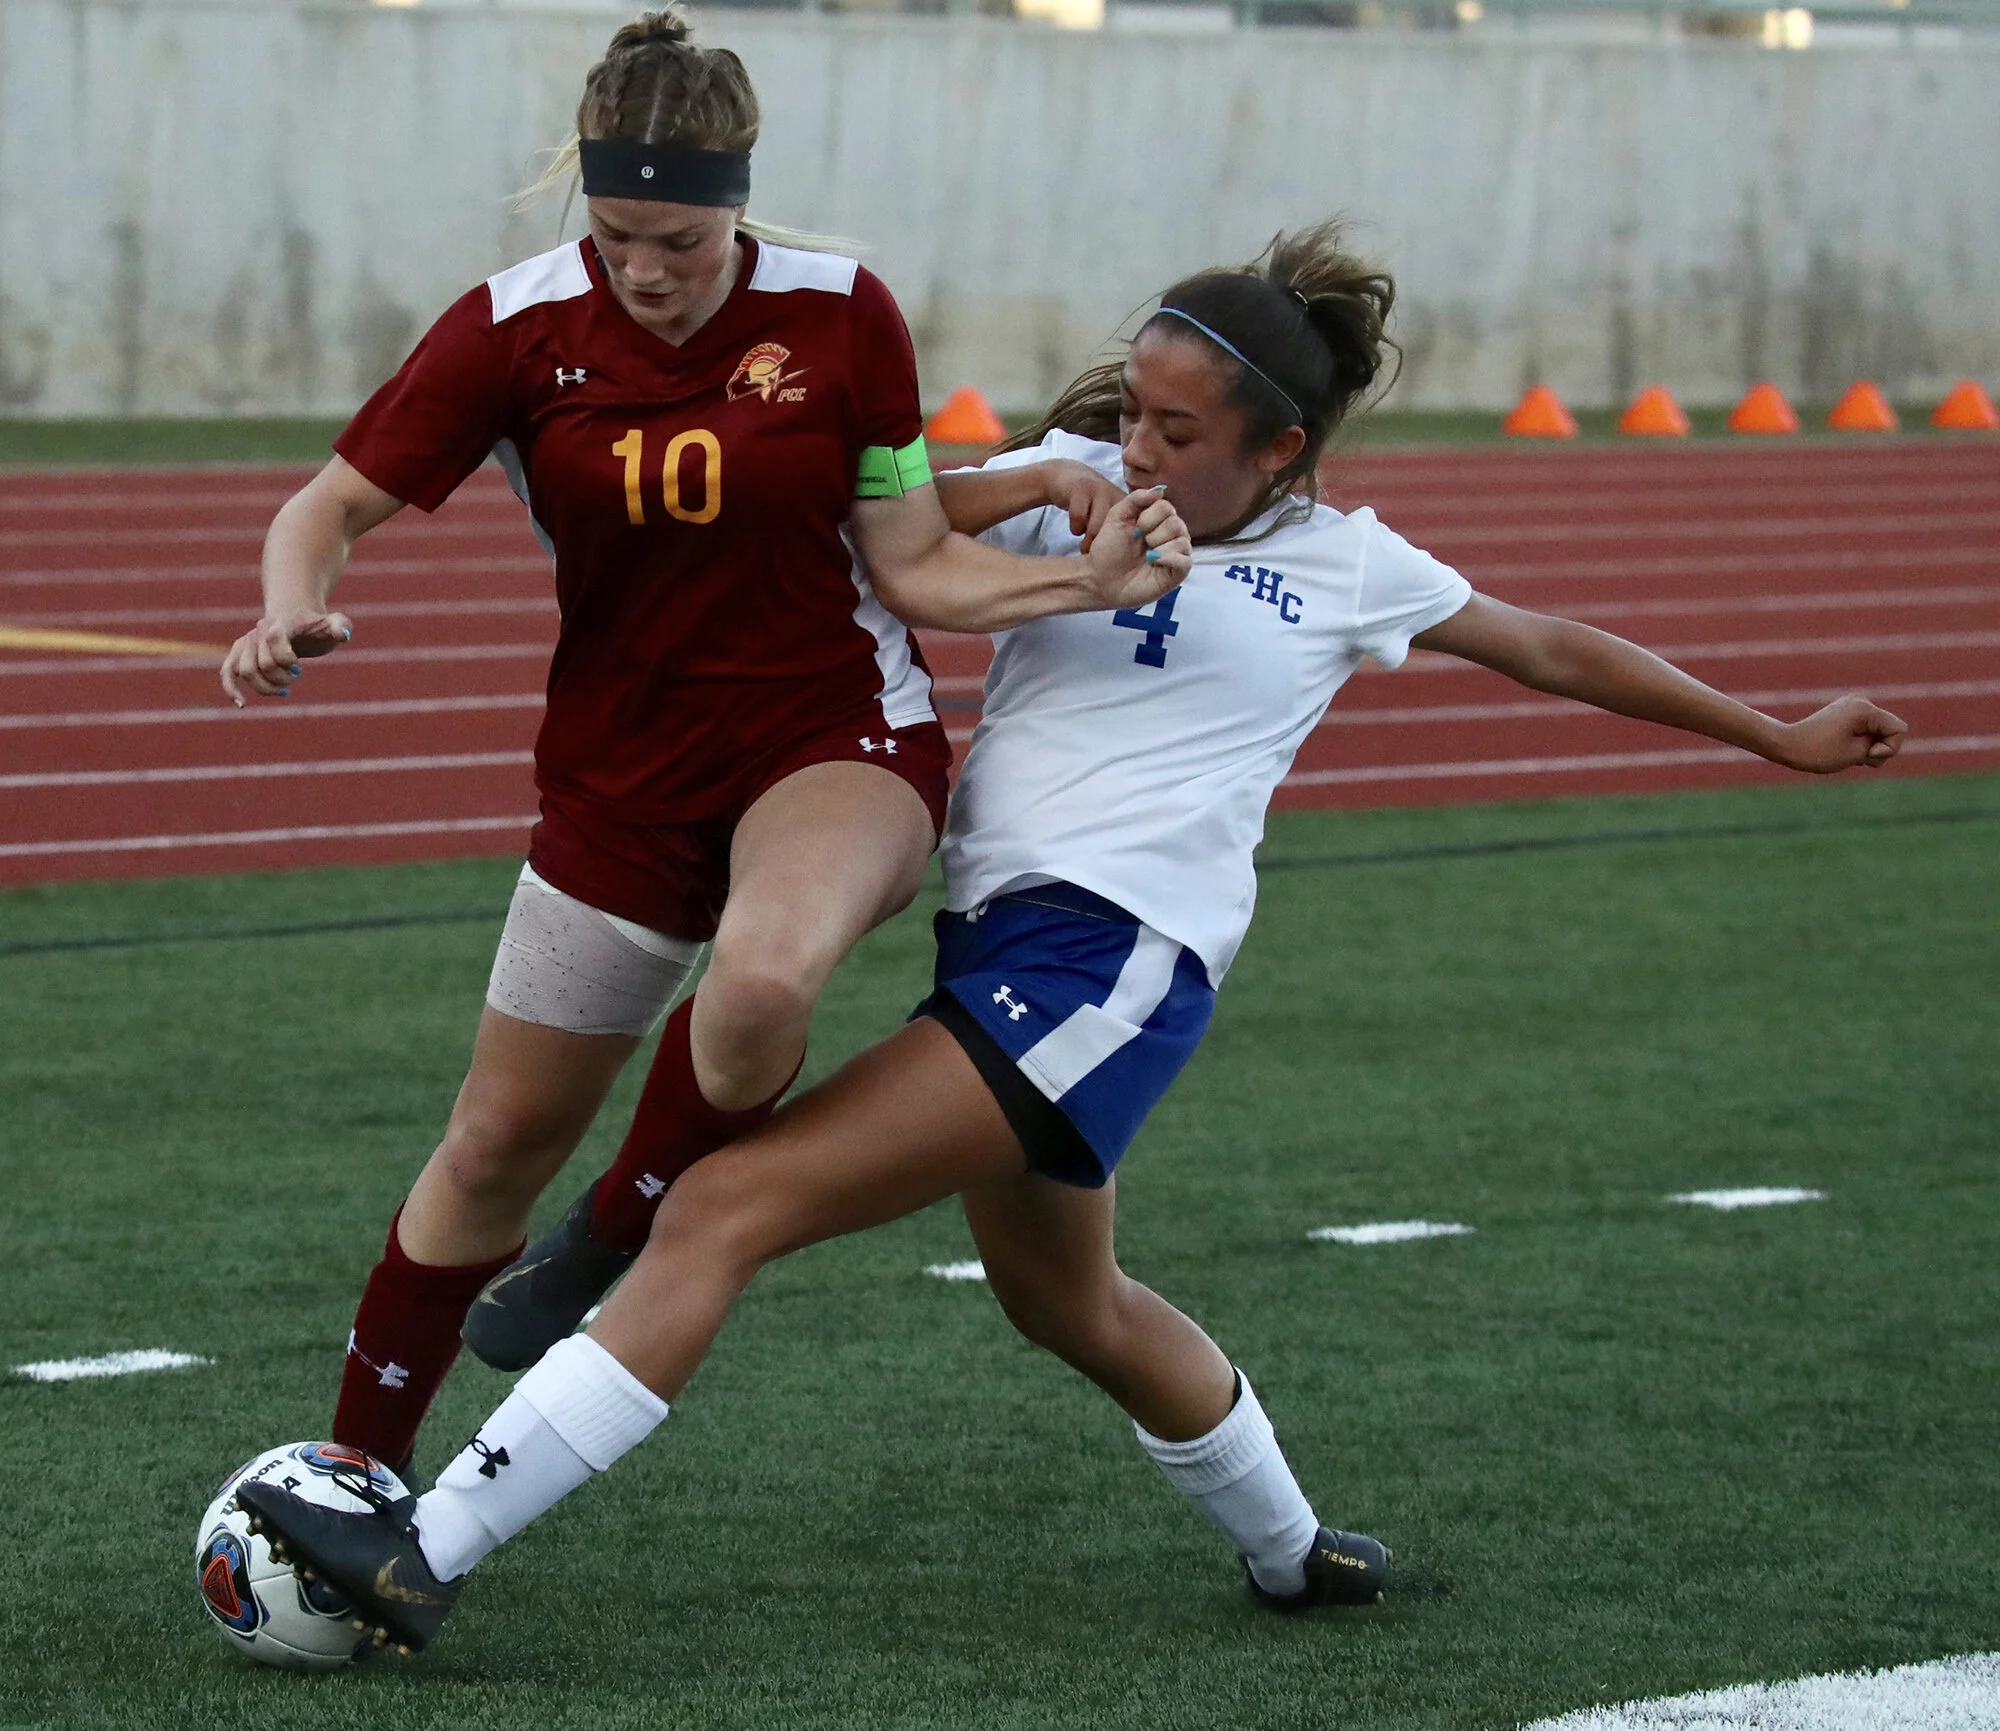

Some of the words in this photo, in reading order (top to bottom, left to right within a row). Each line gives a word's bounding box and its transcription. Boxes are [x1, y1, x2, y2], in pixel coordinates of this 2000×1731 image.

[612, 429, 722, 525] 10
[1112, 586, 1179, 669] 4
[1224, 564, 1303, 624] AHC
[1320, 1549, 1367, 1570] TIEMPO
